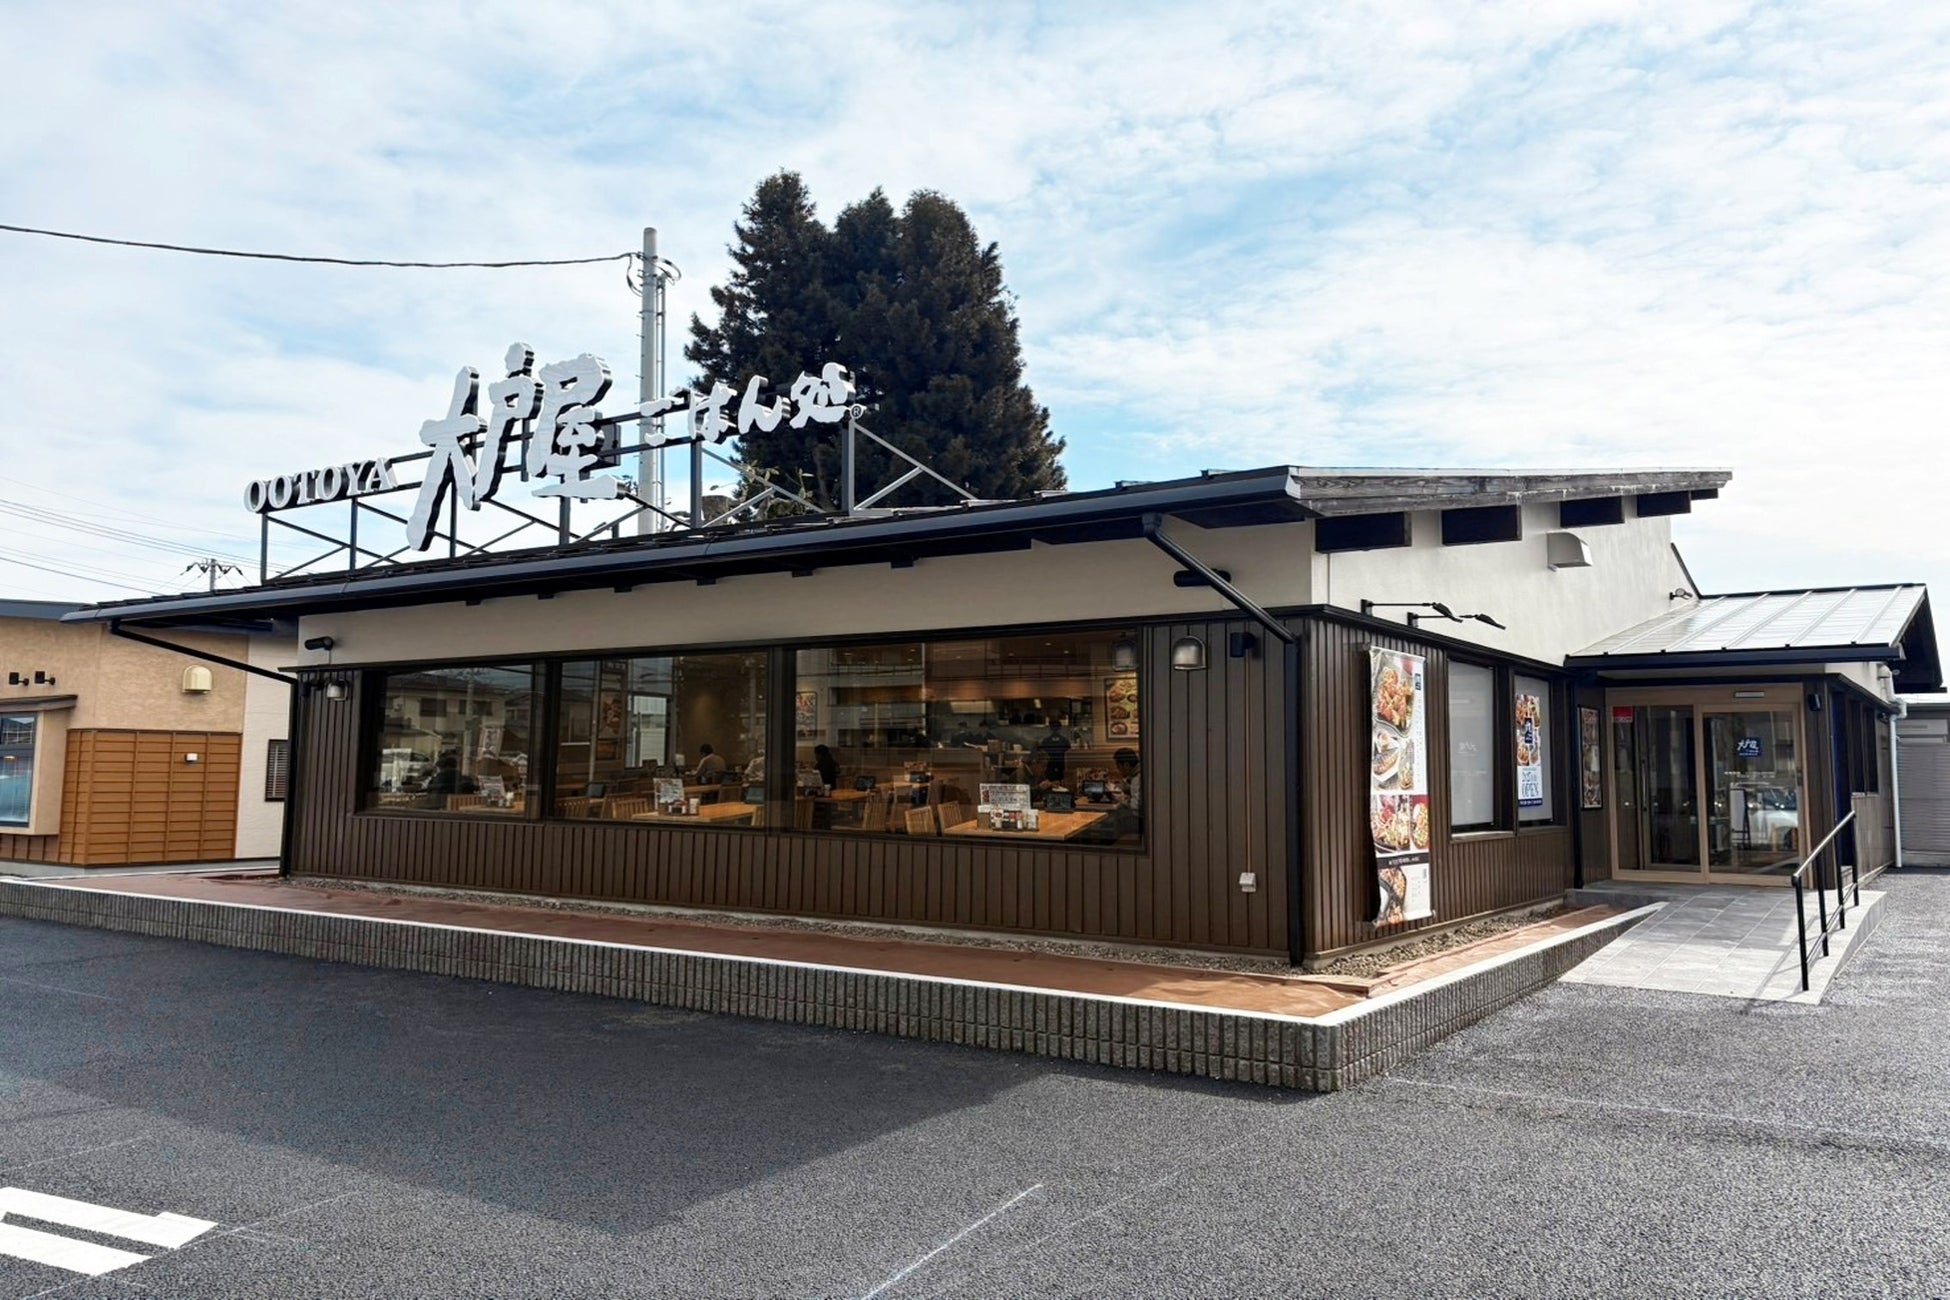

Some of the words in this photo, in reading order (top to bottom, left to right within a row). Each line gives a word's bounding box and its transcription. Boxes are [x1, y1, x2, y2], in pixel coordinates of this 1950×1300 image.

[243, 456, 398, 513] OOTOYA
[406, 342, 627, 551] 大戸屋
